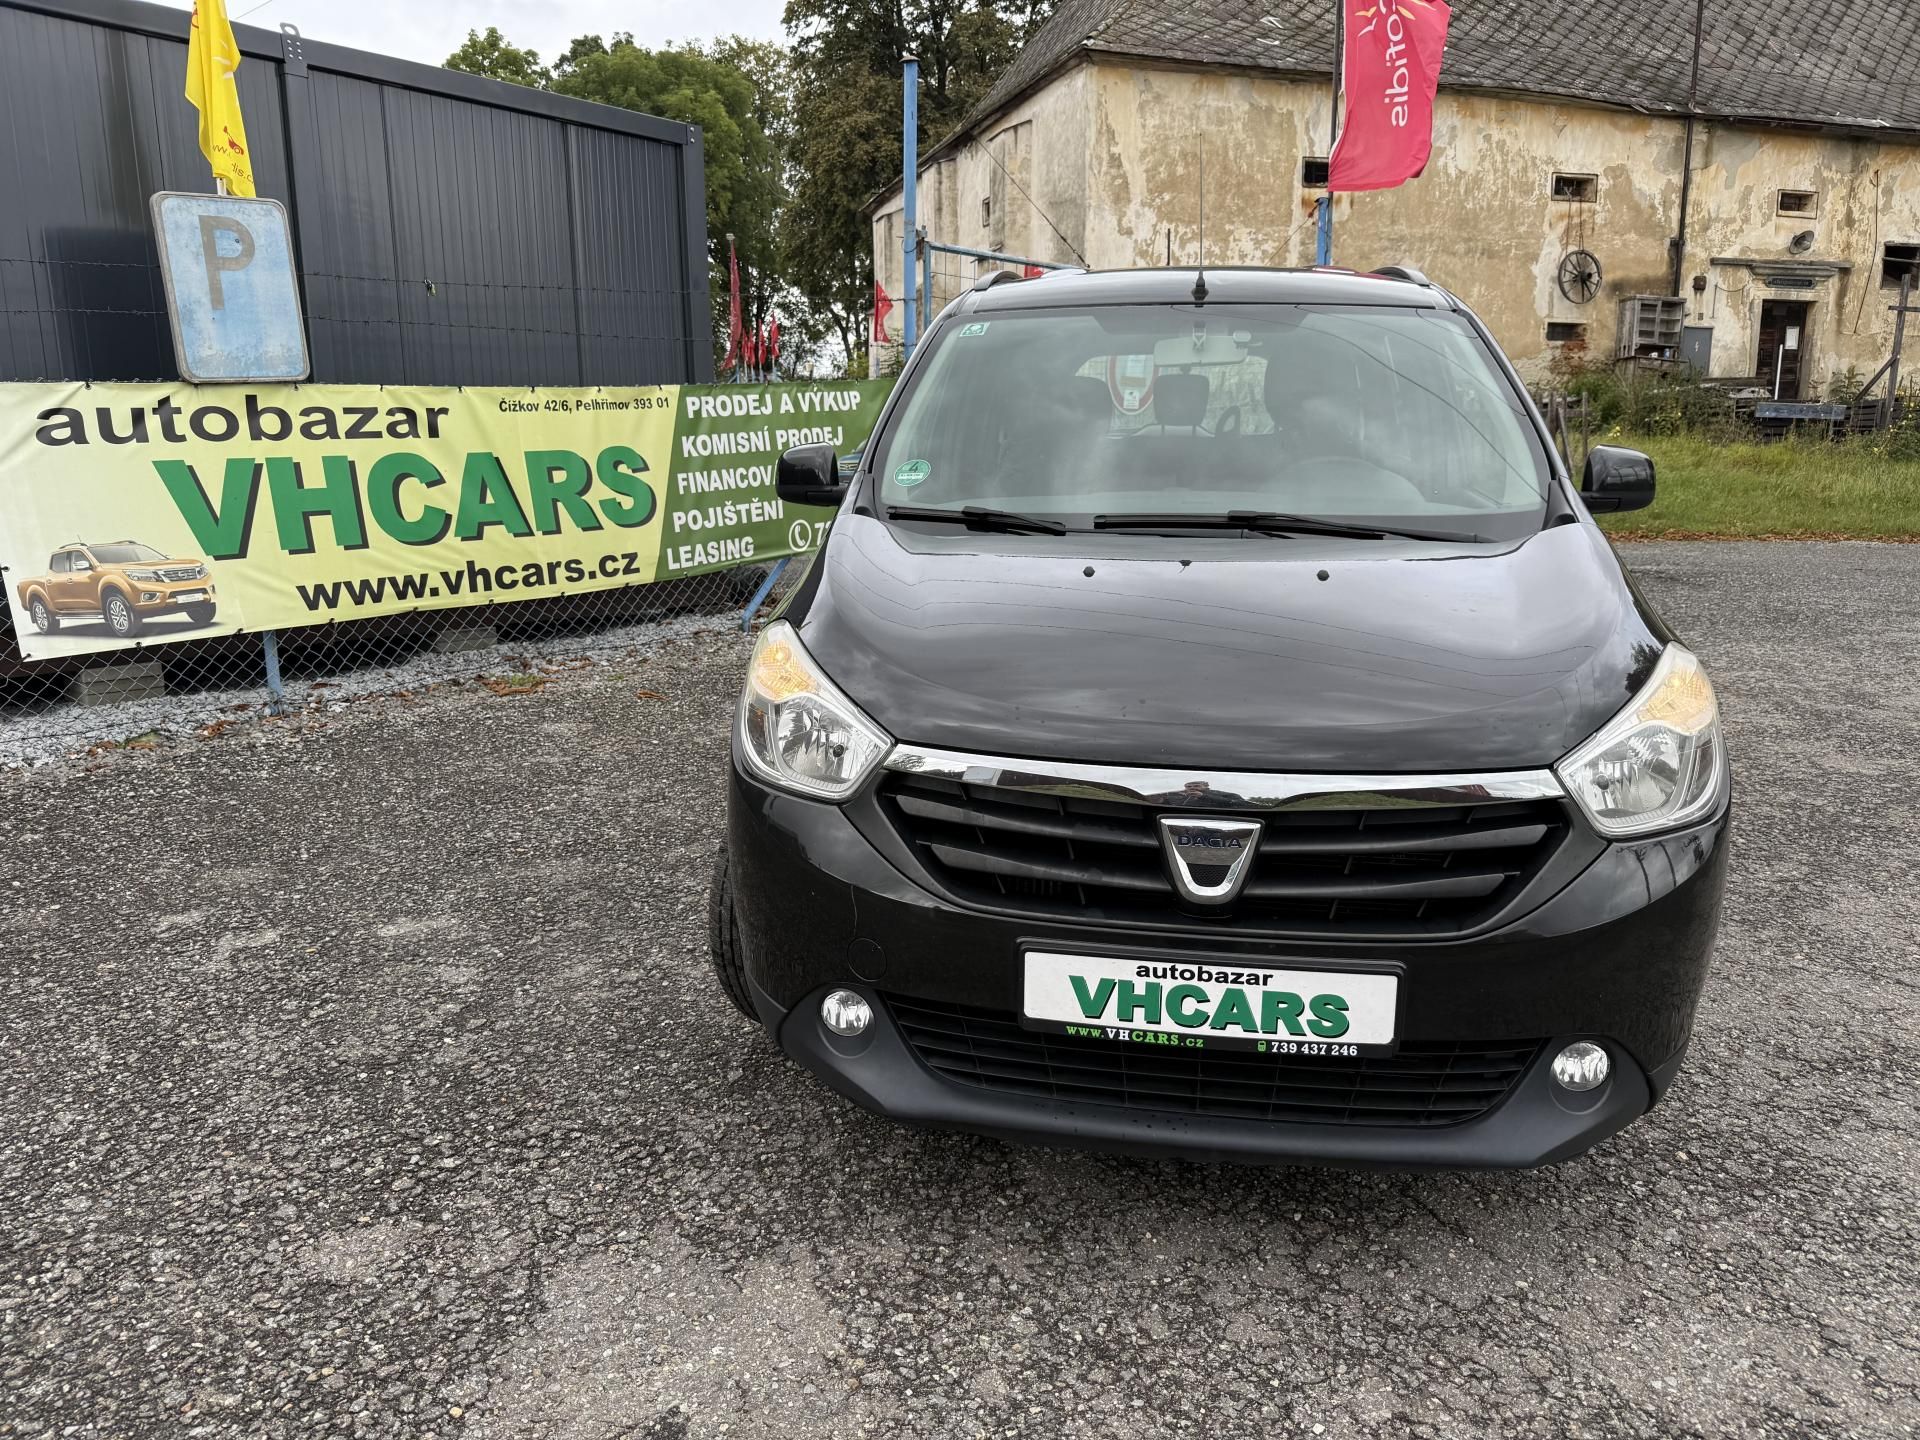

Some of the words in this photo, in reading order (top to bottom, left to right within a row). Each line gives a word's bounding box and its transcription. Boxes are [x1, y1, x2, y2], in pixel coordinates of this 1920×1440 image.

[198, 215, 256, 311] P
[35, 394, 449, 446] autobazar
[499, 397, 540, 412] Čížkov
[543, 400, 573, 414] 42/6,
[576, 398, 630, 411] Pelhřimov
[633, 398, 653, 410] 393
[656, 397, 670, 409] 01
[686, 394, 773, 418] PRODEJ
[779, 393, 795, 414] A
[797, 390, 861, 413] VÝKUP
[682, 426, 771, 457] KOMISNÍ
[776, 426, 843, 451] PRODEJ
[677, 462, 778, 495] FINANCOV
[152, 446, 657, 561] VHCARS
[666, 537, 755, 570] LEASING
[296, 552, 640, 611] www.vhcars.cz
[1177, 834, 1243, 849] DACIA
[1135, 964, 1273, 986] autobazar
[1068, 975, 1350, 1039] VHCARS
[1271, 1041, 1297, 1054] 739
[1301, 1042, 1325, 1055] 437
[1331, 1044, 1358, 1057] 246
